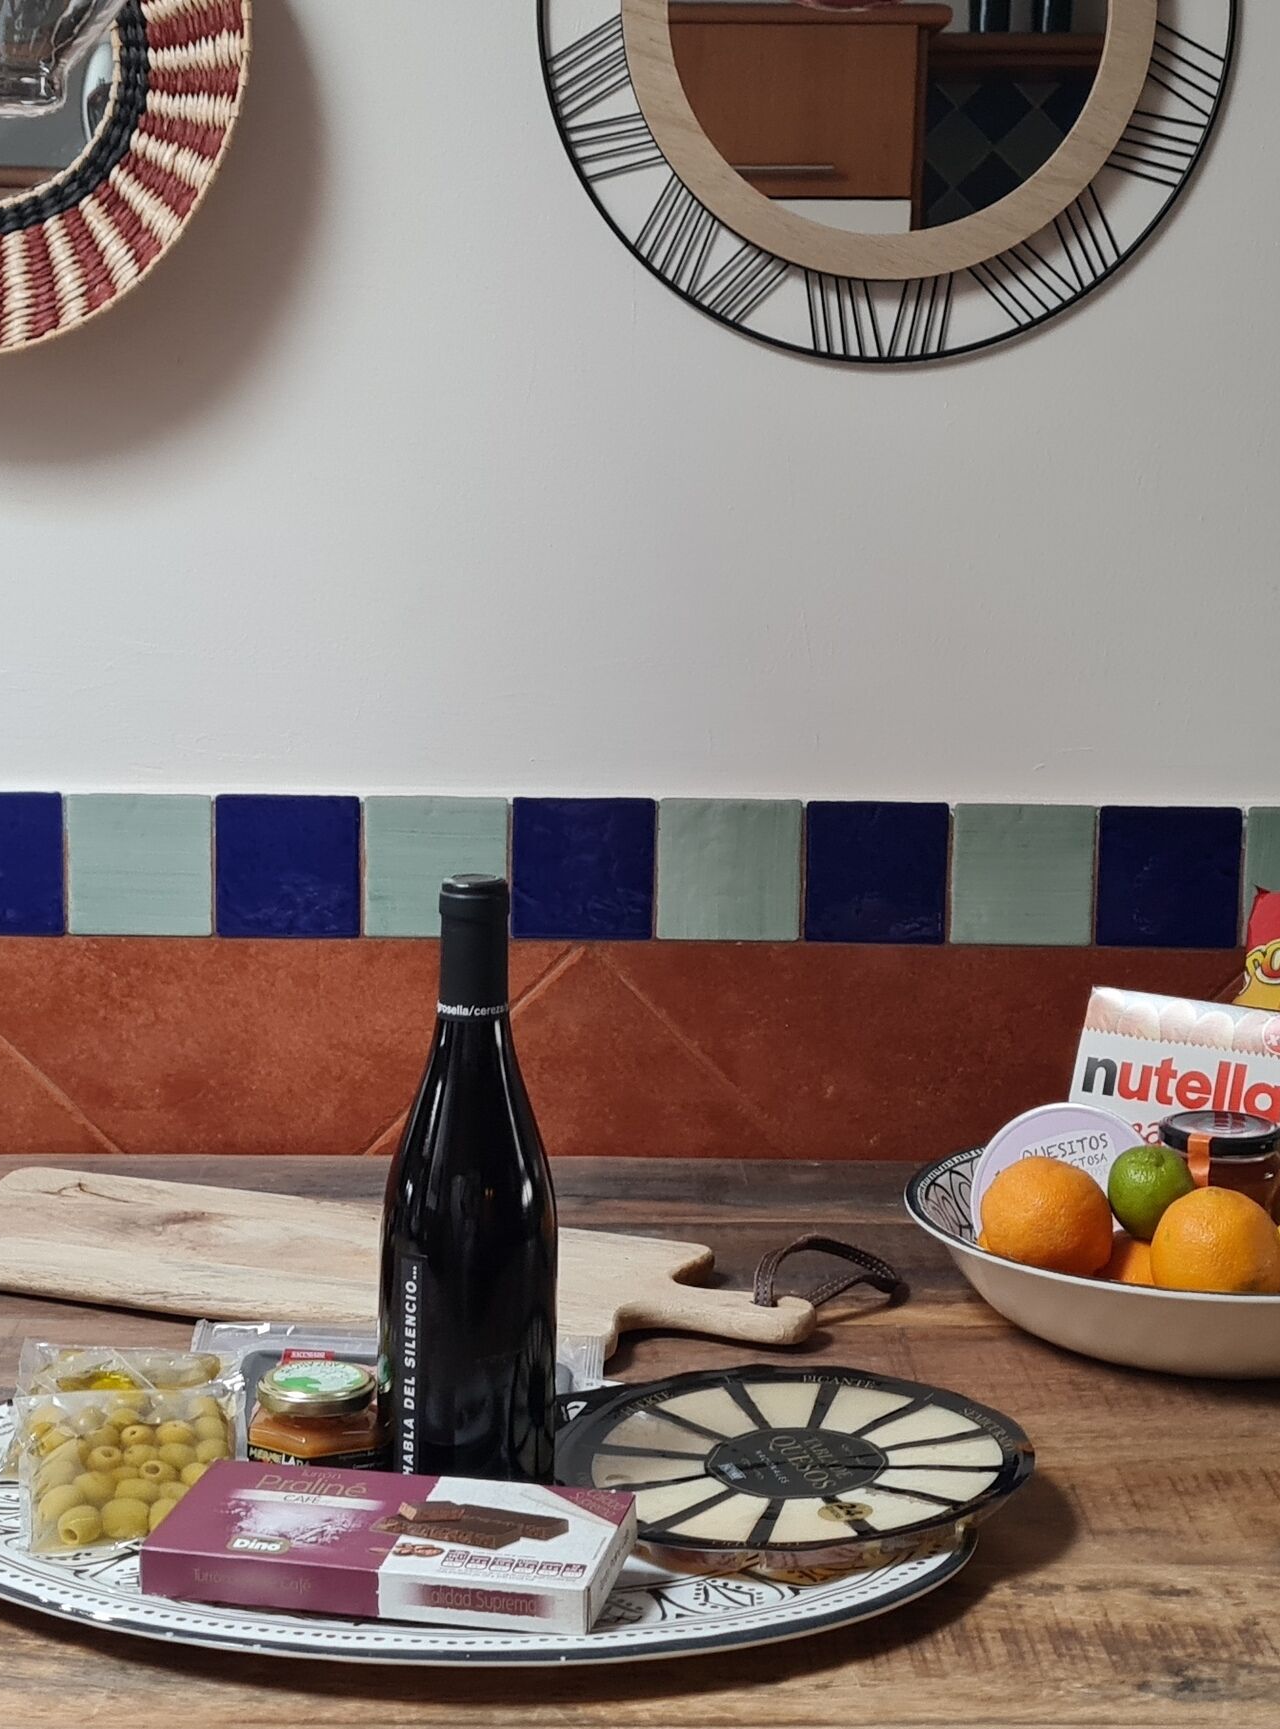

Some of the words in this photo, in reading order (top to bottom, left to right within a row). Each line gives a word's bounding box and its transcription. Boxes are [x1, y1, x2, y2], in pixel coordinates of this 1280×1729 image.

[1022, 1133, 1109, 1160] QUESITOS
[1070, 1153, 1108, 1169] CTOSA
[404, 1265, 418, 1369] SILENCIO...
[403, 1376, 417, 1411] DEL
[803, 1375, 877, 1391] PICANTE
[402, 1418, 416, 1476] HABLA
[770, 1435, 836, 1490] QUESOS
[255, 1474, 368, 1497] Praliné
[232, 1538, 282, 1551] Dino
[192, 1567, 222, 1584] Turró
[431, 1587, 471, 1607] alidad
[475, 1591, 537, 1613] Suprema
